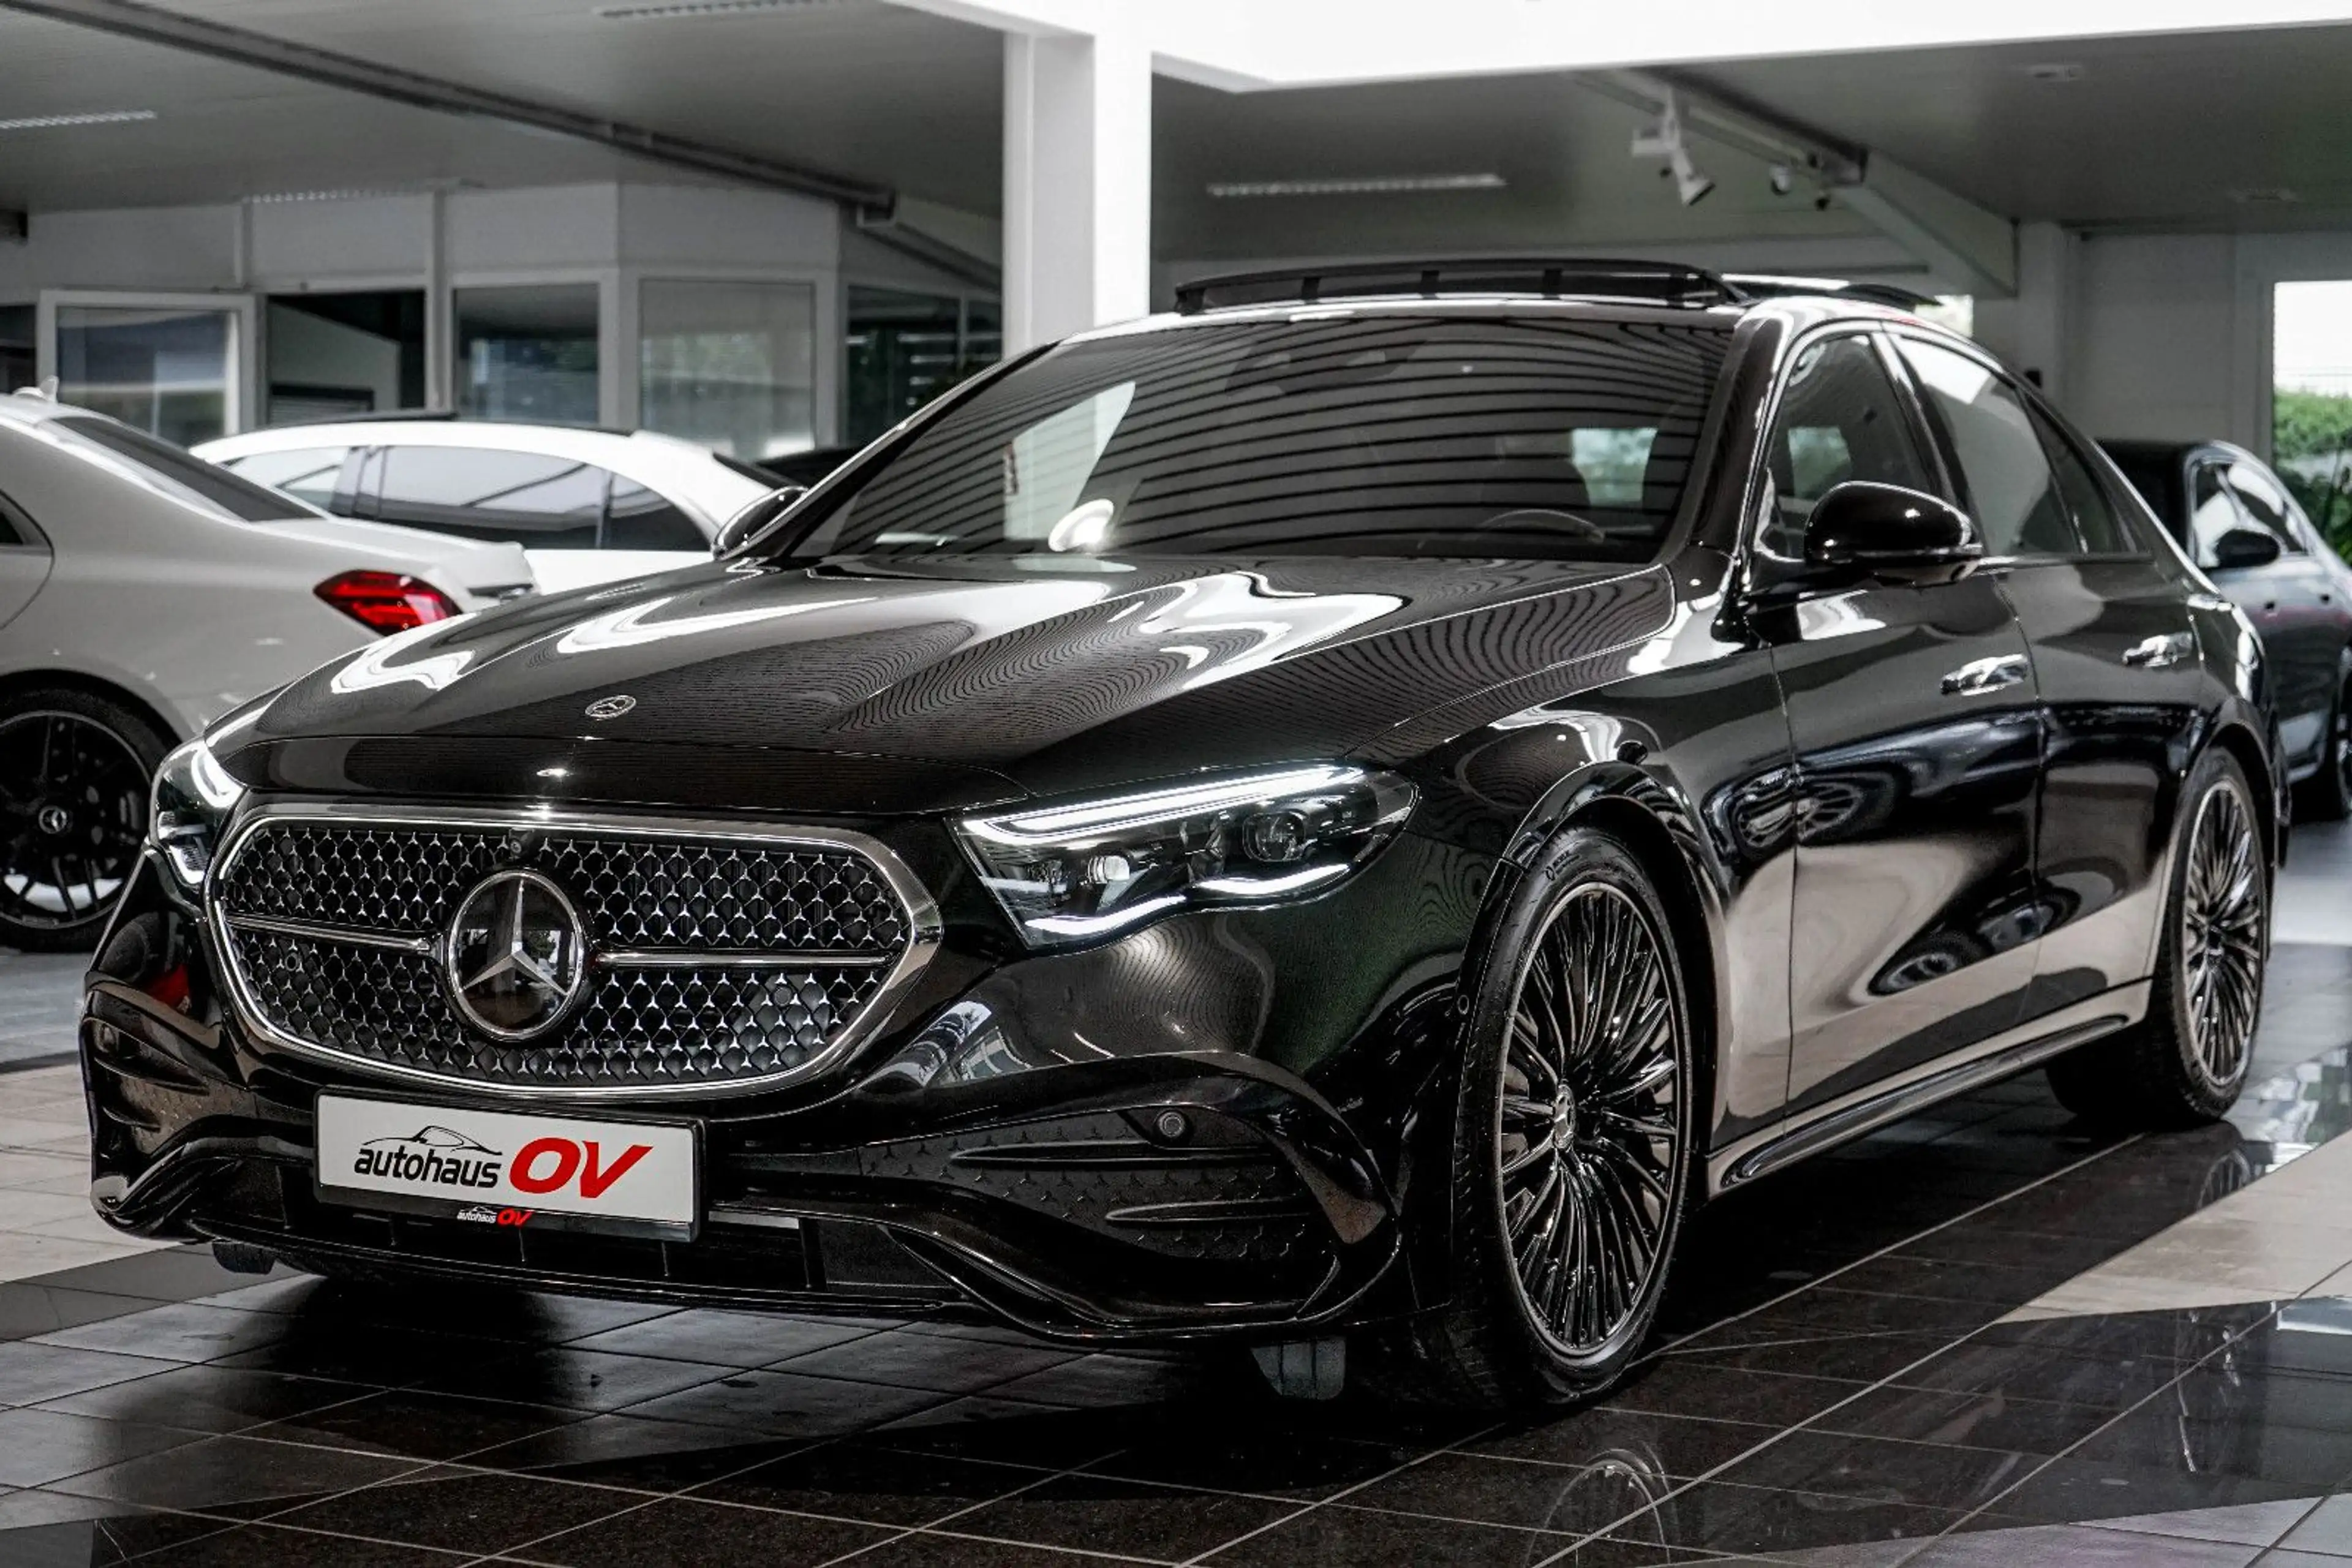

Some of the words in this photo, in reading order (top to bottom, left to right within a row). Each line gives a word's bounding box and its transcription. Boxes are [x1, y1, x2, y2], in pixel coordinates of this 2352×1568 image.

[354, 1145, 502, 1188] autohaus
[508, 1137, 653, 1199] OV
[456, 1210, 497, 1224] autohaus
[497, 1207, 533, 1227] OV
